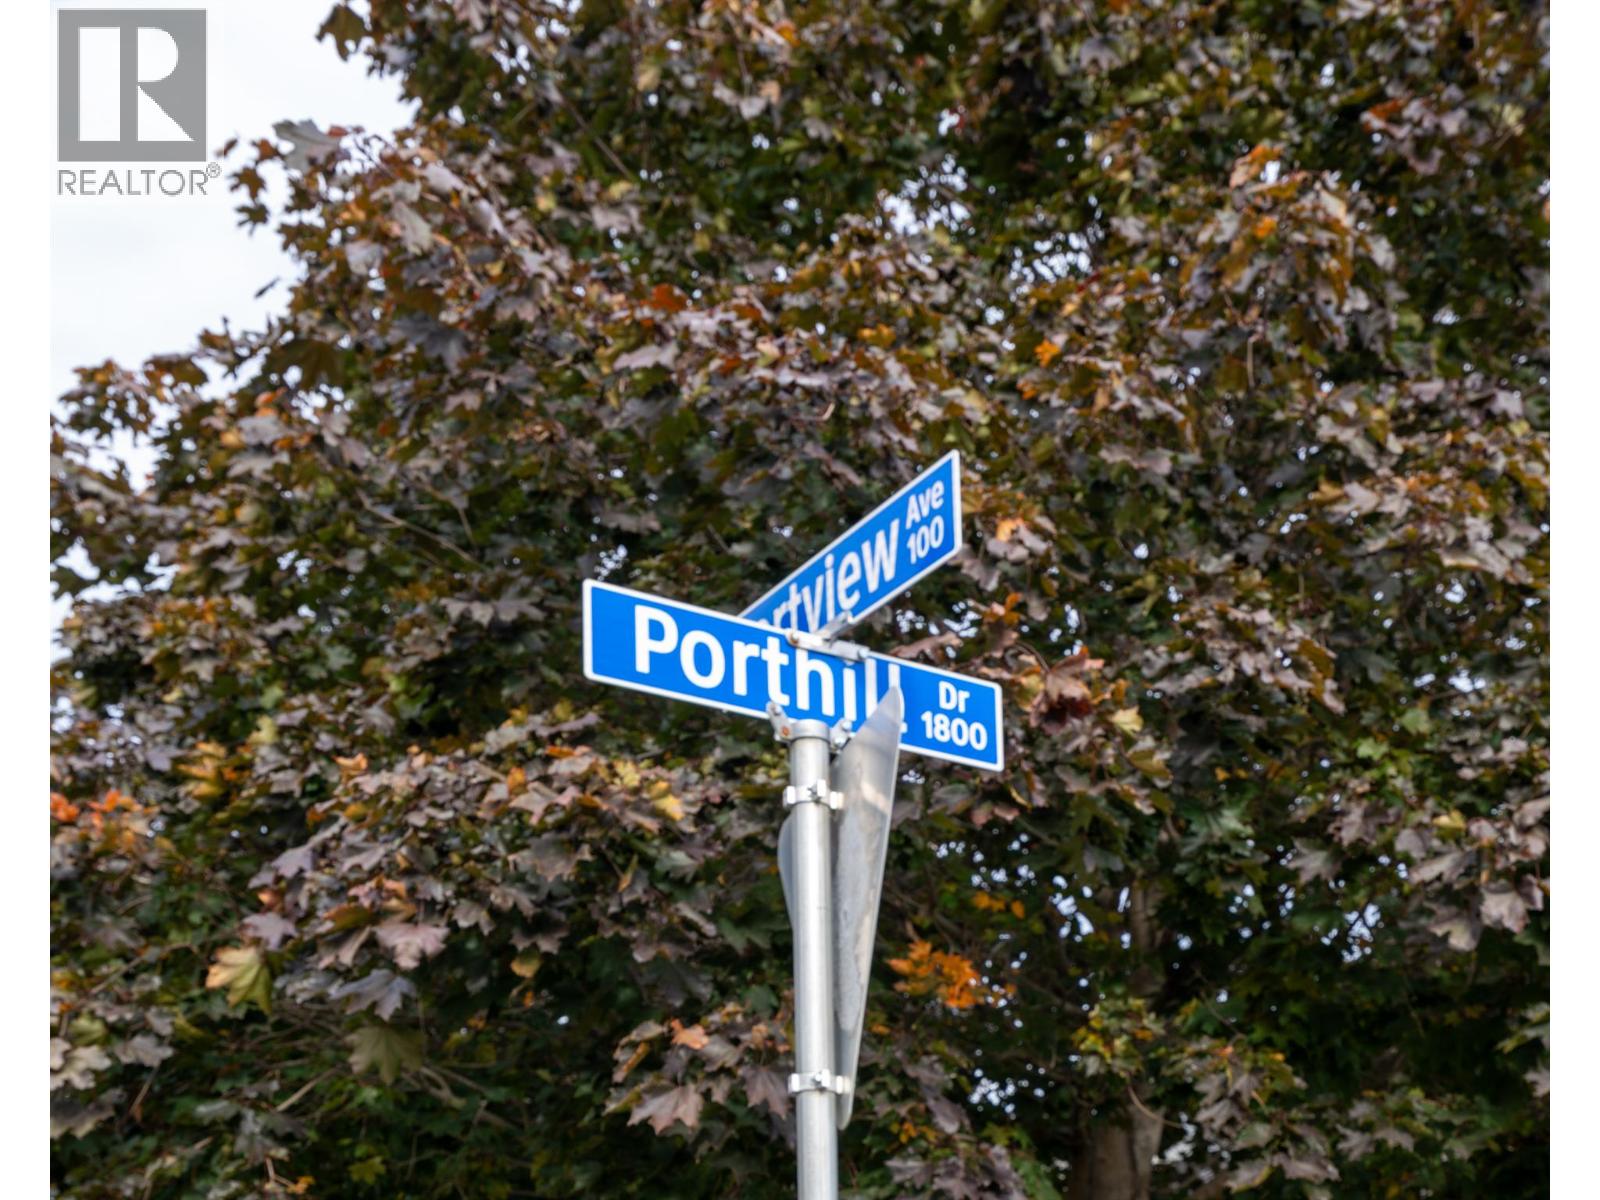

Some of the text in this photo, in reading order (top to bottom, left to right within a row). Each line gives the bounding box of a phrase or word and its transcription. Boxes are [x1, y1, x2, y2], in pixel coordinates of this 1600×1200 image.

[757, 480, 945, 633] rtview Ave
[907, 515, 945, 565] 100
[938, 681, 970, 713] Dr
[920, 710, 988, 751] 1800
